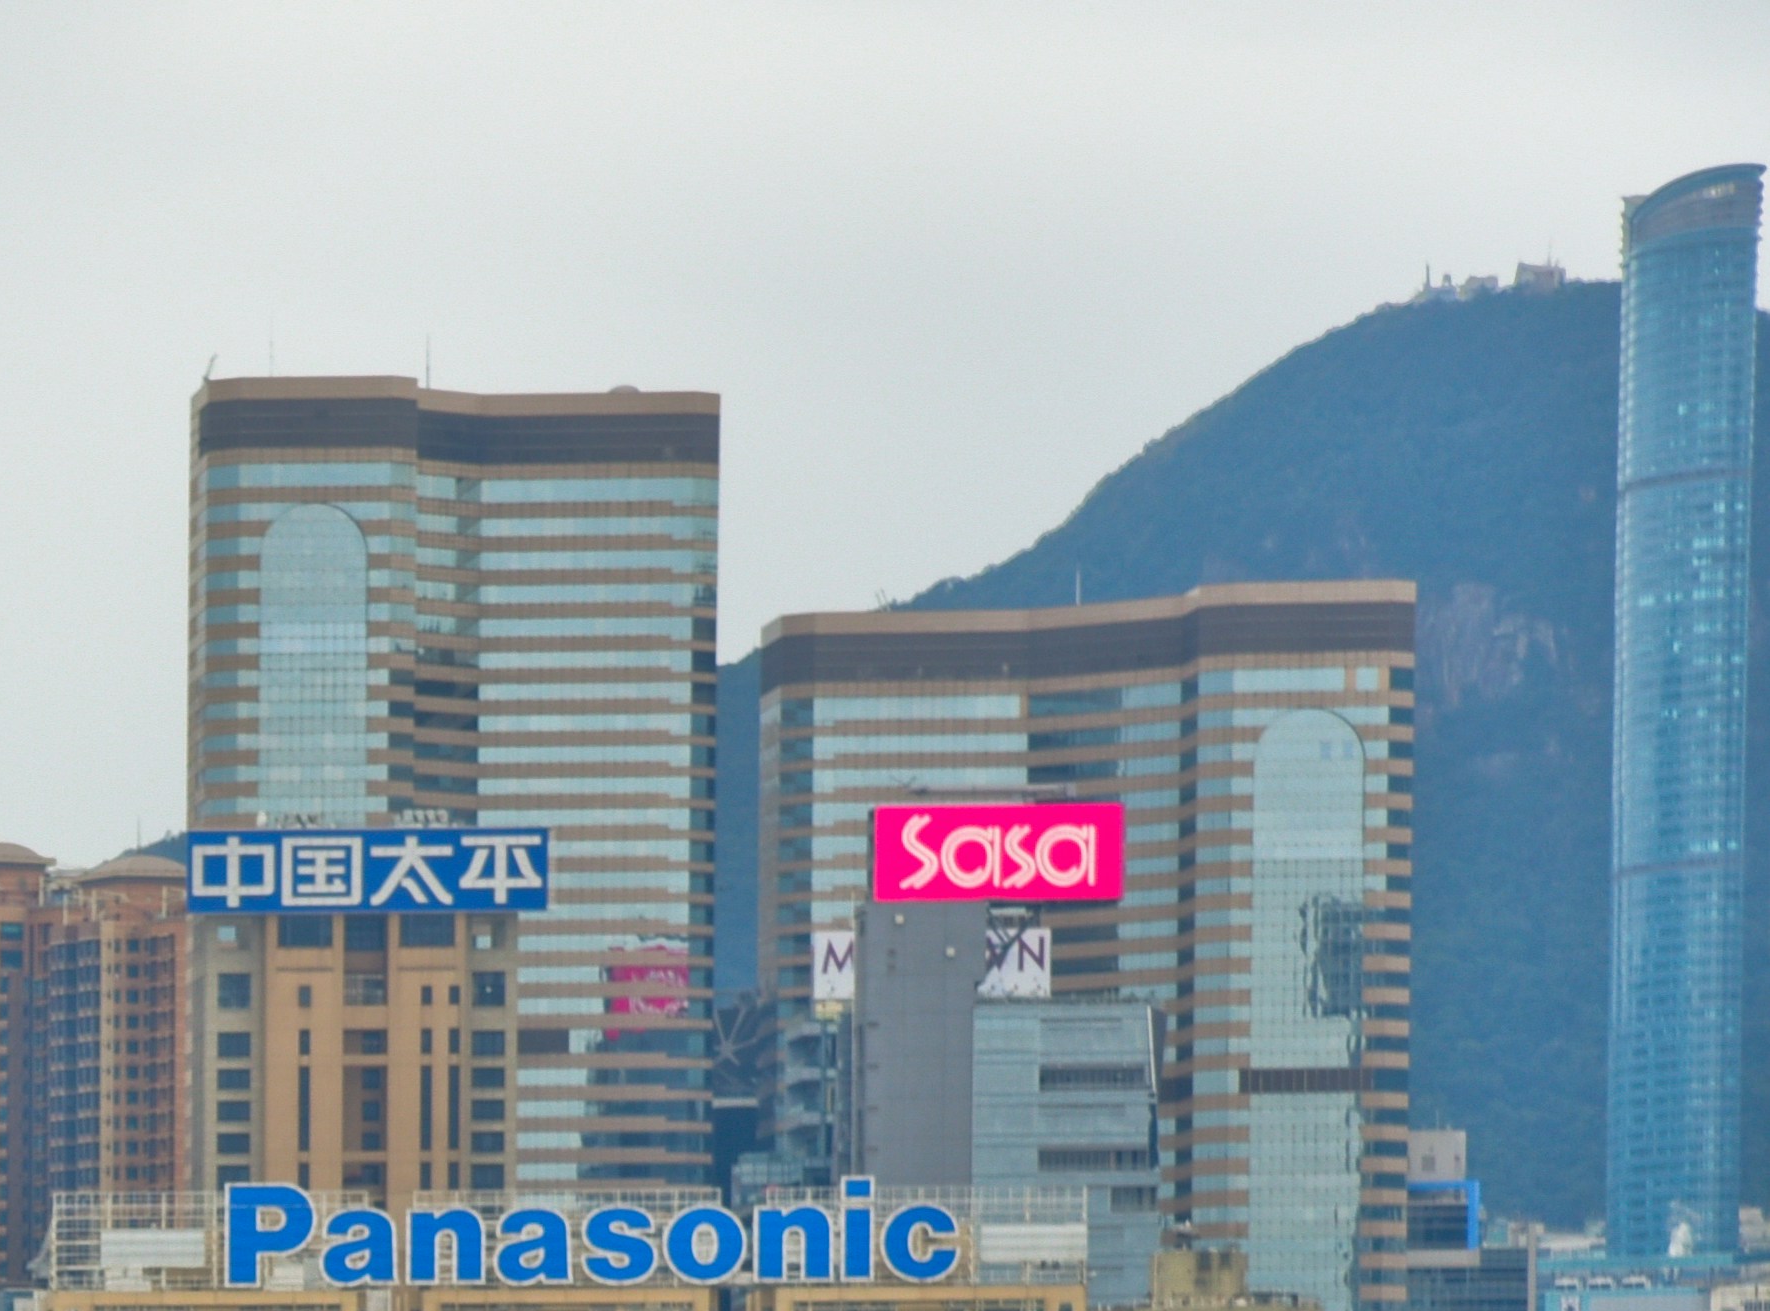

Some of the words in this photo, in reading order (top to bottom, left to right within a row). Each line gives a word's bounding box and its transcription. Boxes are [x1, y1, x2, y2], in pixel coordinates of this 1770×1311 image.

[191, 834, 543, 908] 中国太平
[224, 1175, 962, 1287] Panasonic
